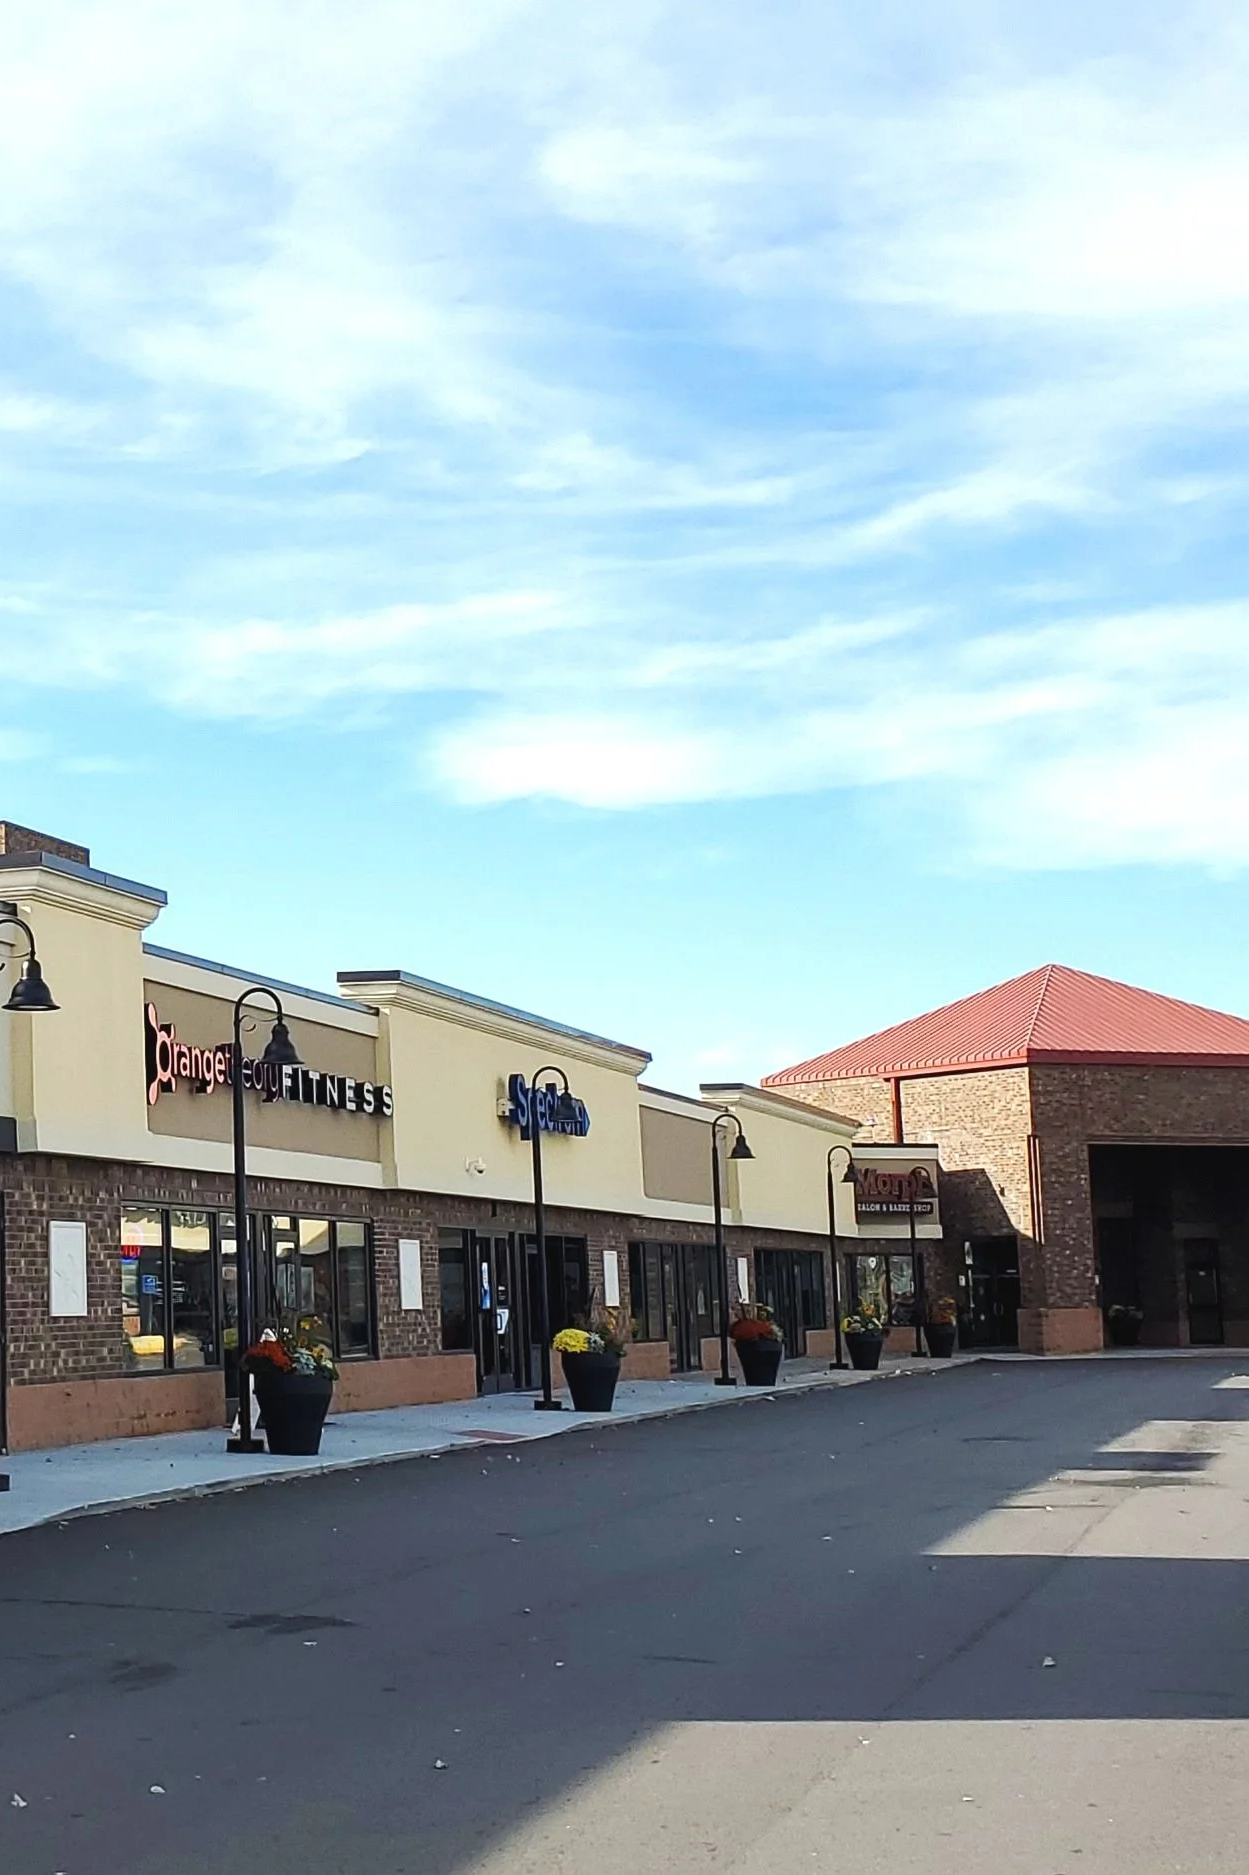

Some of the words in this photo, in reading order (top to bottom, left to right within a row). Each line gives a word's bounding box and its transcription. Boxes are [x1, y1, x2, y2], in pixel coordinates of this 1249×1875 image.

[149, 1002, 281, 1106] Orangeteory
[281, 1064, 393, 1117] FITNESS
[857, 1203, 881, 1212] SALON
[889, 1203, 912, 1212] BARBE
[913, 1204, 931, 1212] SHOP
